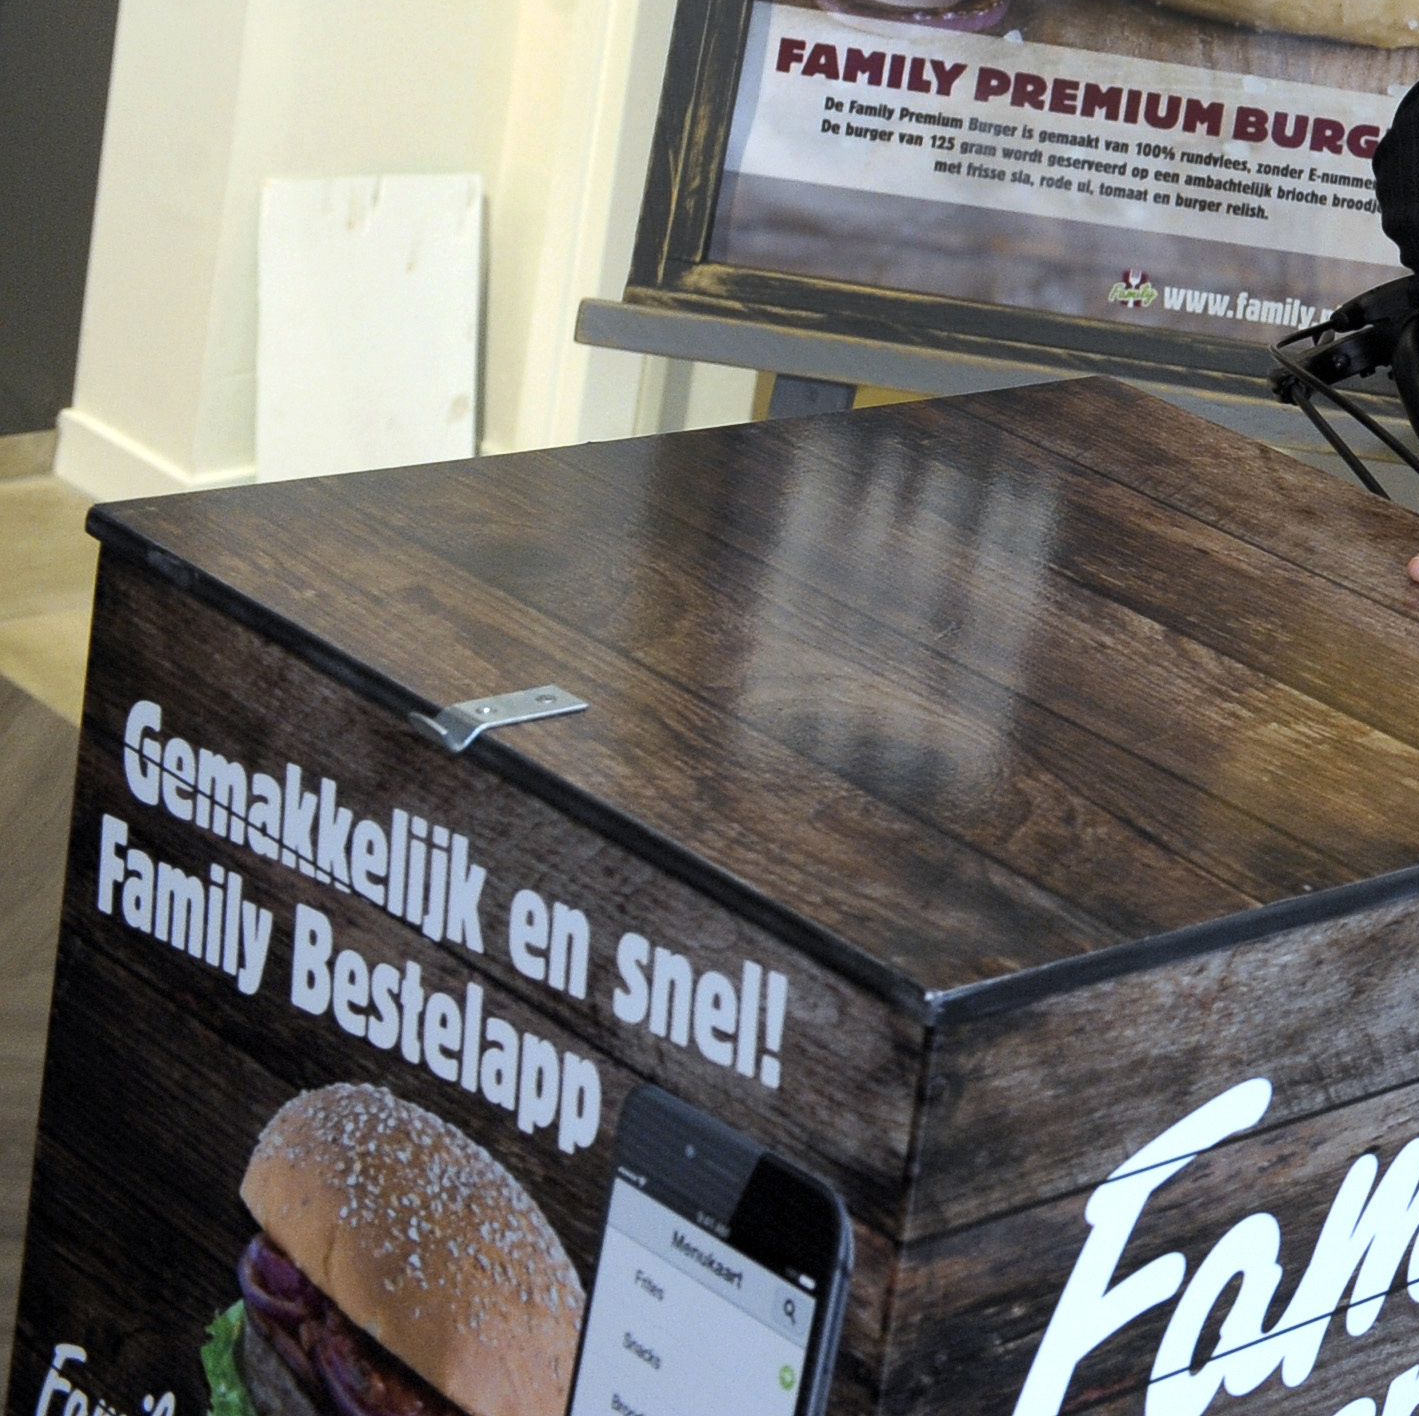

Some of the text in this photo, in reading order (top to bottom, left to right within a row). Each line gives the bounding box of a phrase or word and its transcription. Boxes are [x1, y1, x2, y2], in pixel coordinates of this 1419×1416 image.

[776, 38, 1384, 160] FAMILY PREMIUM BURG
[824, 97, 844, 113] De
[849, 100, 895, 121] Family
[900, 107, 963, 129] Premium
[968, 116, 1017, 139] Burger
[1022, 124, 1034, 140] is
[1038, 126, 1099, 150] gemaakt
[1104, 139, 1129, 154] van
[1135, 141, 1176, 161] 100%
[1180, 150, 1252, 173] rundvlees,
[1256, 161, 1304, 181] zonder
[821, 119, 840, 134] De
[846, 122, 895, 143] burger
[898, 131, 923, 146] van
[930, 134, 955, 151] 125
[960, 141, 997, 158] gram
[1002, 146, 1042, 164] wordt
[1048, 154, 1127, 177] geserveerd
[1132, 166, 1148, 181] op
[1154, 169, 1180, 184] een
[1184, 173, 1272, 199] ambachtelijk
[1277, 184, 1327, 206] brioche
[934, 159, 961, 174] met
[966, 162, 1006, 182] frisse
[1010, 169, 1034, 186] sla,
[1040, 174, 1072, 191] rode
[1099, 184, 1148, 202] tomaat
[1153, 191, 1170, 205] en
[1175, 193, 1222, 214] burger
[1226, 201, 1269, 220] relish.
[1108, 282, 1158, 307] Family
[1164, 286, 1341, 330] www.family.n
[124, 700, 788, 1089] Gemakkelijk en snel!
[98, 814, 600, 1153] Family Bestelapp
[672, 1231, 743, 1289] Menukaart
